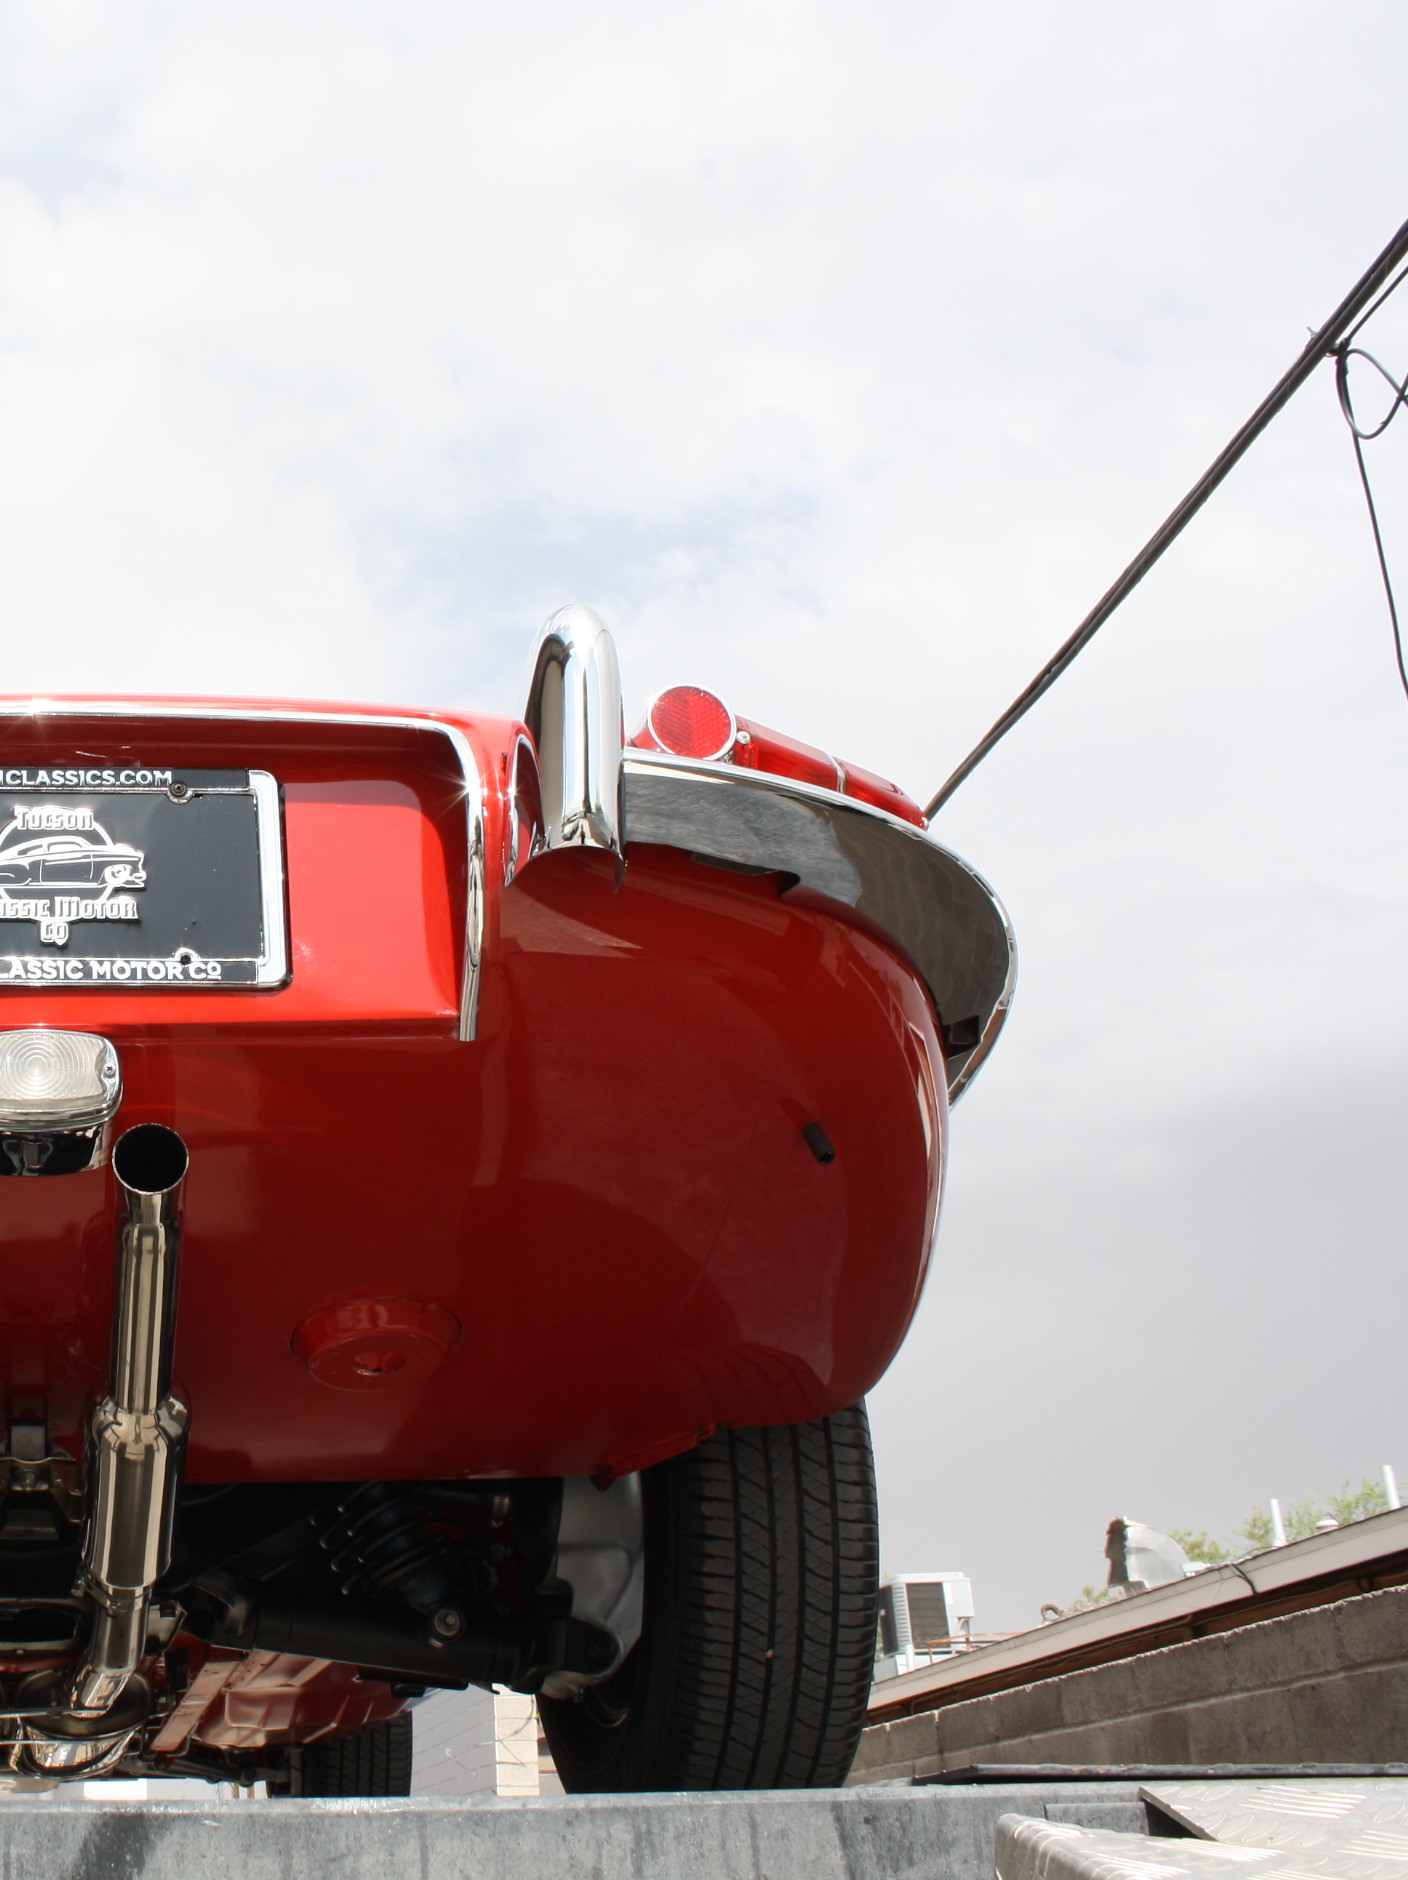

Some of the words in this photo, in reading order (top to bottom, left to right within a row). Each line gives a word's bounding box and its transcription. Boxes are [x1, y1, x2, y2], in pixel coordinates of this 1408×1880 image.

[14, 805, 93, 829] TUCSON
[54, 896, 138, 919] MOTOR
[90, 961, 184, 980] MOTOR
